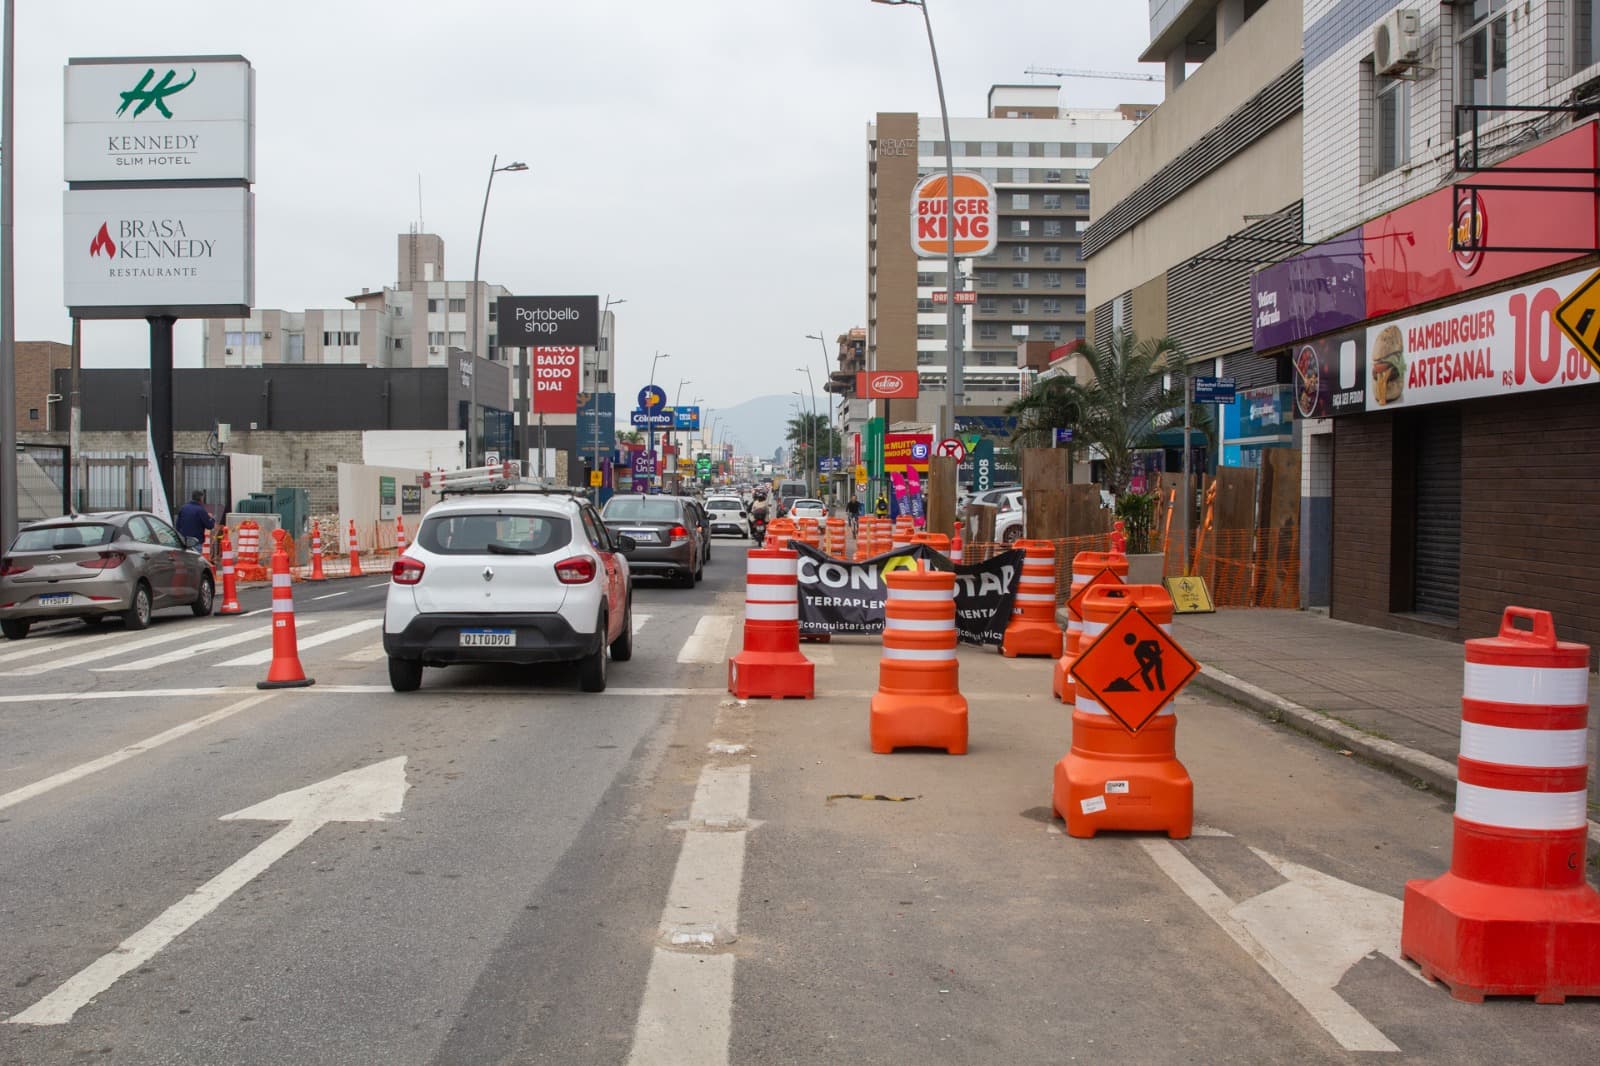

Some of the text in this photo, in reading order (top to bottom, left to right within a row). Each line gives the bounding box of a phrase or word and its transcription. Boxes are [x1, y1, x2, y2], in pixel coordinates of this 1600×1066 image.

[108, 134, 199, 151] KENNEDY
[116, 156, 191, 166] SLIM HOTEL
[120, 219, 187, 238] BRASA
[918, 216, 989, 238] KING
[120, 239, 216, 259] KENNEDY
[109, 267, 198, 278] RESTAURANTE
[933, 293, 975, 302] DRI-THRU
[515, 307, 580, 322] Portobello
[525, 320, 558, 335] shop
[1408, 309, 1495, 353] HAMBURGUER
[537, 355, 575, 365] BAIXO
[537, 368, 571, 378] TODO
[1408, 347, 1494, 389] ARTESANAL
[537, 381, 562, 391] DIA!
[1502, 368, 1513, 389] R$
[633, 414, 671, 422] Colombo
[979, 458, 989, 491] COOB
[806, 596, 887, 609] TERRAPLEN
